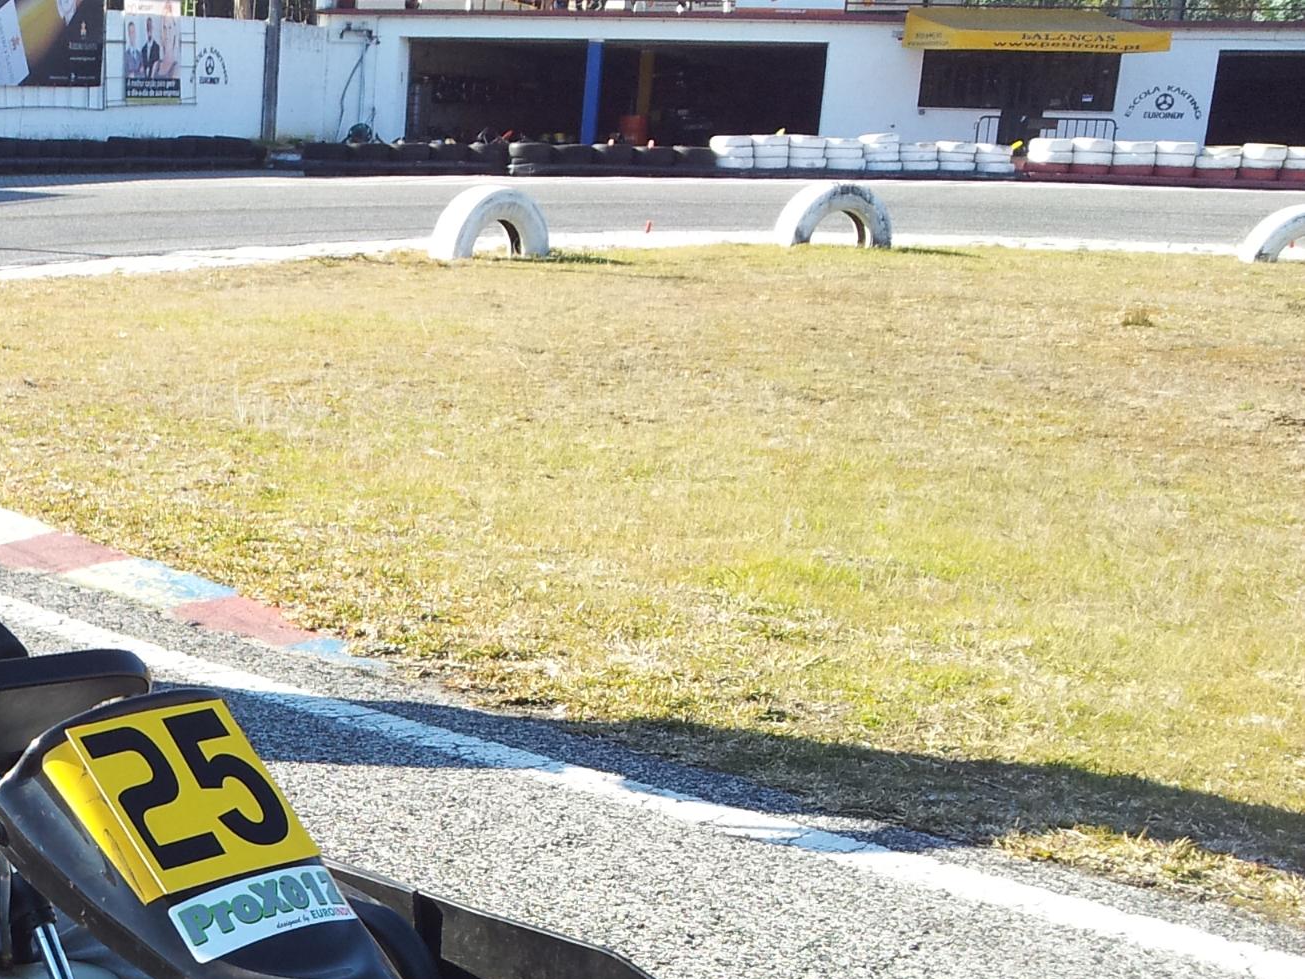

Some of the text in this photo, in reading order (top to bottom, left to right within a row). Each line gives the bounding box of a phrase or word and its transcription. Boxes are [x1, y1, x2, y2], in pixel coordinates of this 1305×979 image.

[1124, 85, 1201, 120] ESCOLA KARTING
[1143, 111, 1184, 119] EUROINDY
[80, 708, 289, 870] 25
[178, 870, 346, 946] ProX012
[276, 916, 302, 928] designed
[302, 914, 310, 922] by
